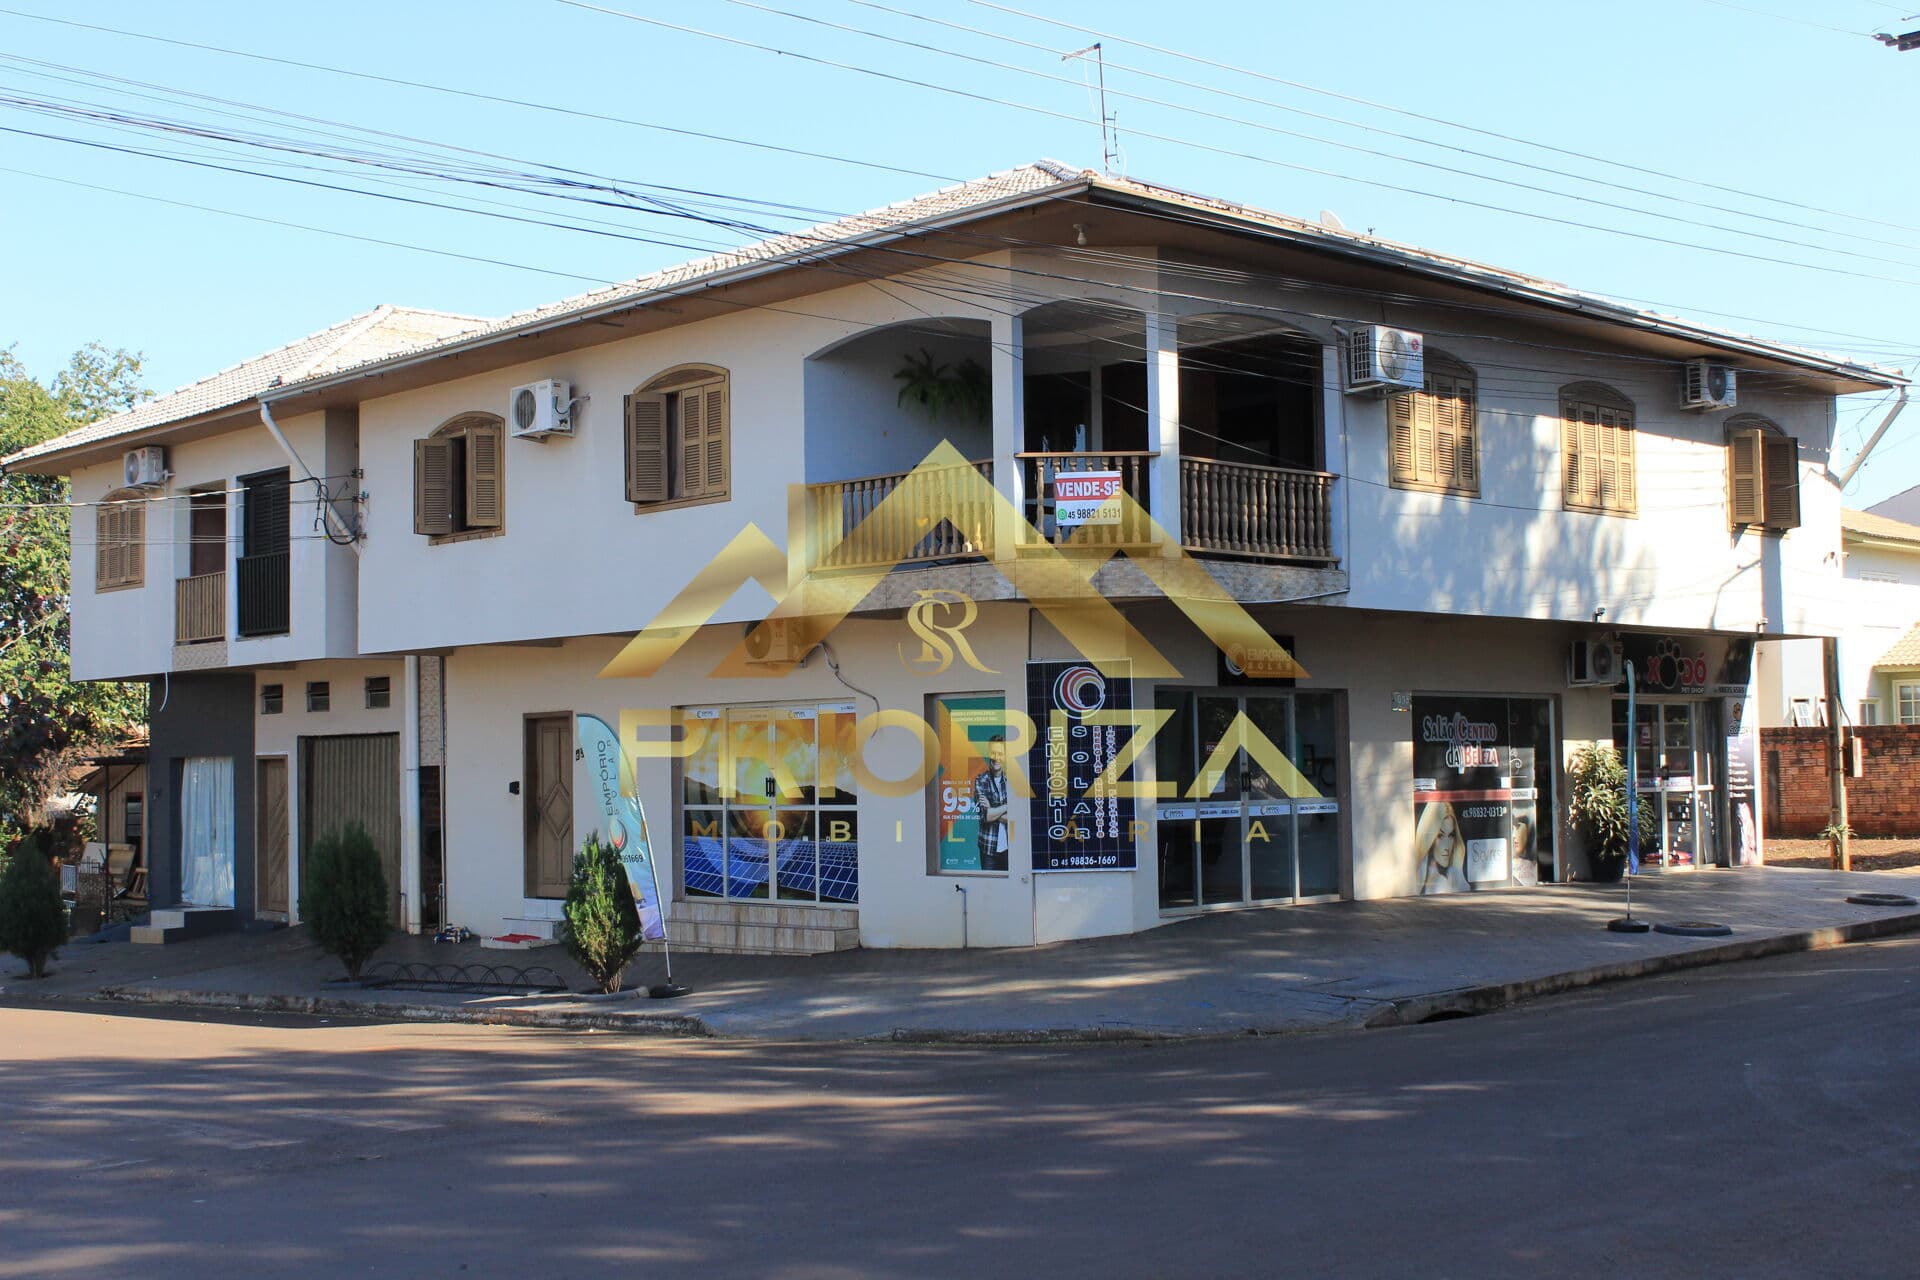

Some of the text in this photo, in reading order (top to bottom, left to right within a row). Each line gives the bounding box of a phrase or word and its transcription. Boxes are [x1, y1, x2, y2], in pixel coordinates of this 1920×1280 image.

[1056, 481, 1120, 497] VENDE-SE
[1077, 508, 1100, 519] 98821
[1102, 507, 1121, 519] 5131
[597, 740, 614, 816] EMPÓRIO
[1045, 726, 1069, 840] EMPÓRIO
[1071, 725, 1092, 840] SOLAR
[943, 786, 980, 813] 95%
[1070, 855, 1117, 866] 98836-1669
